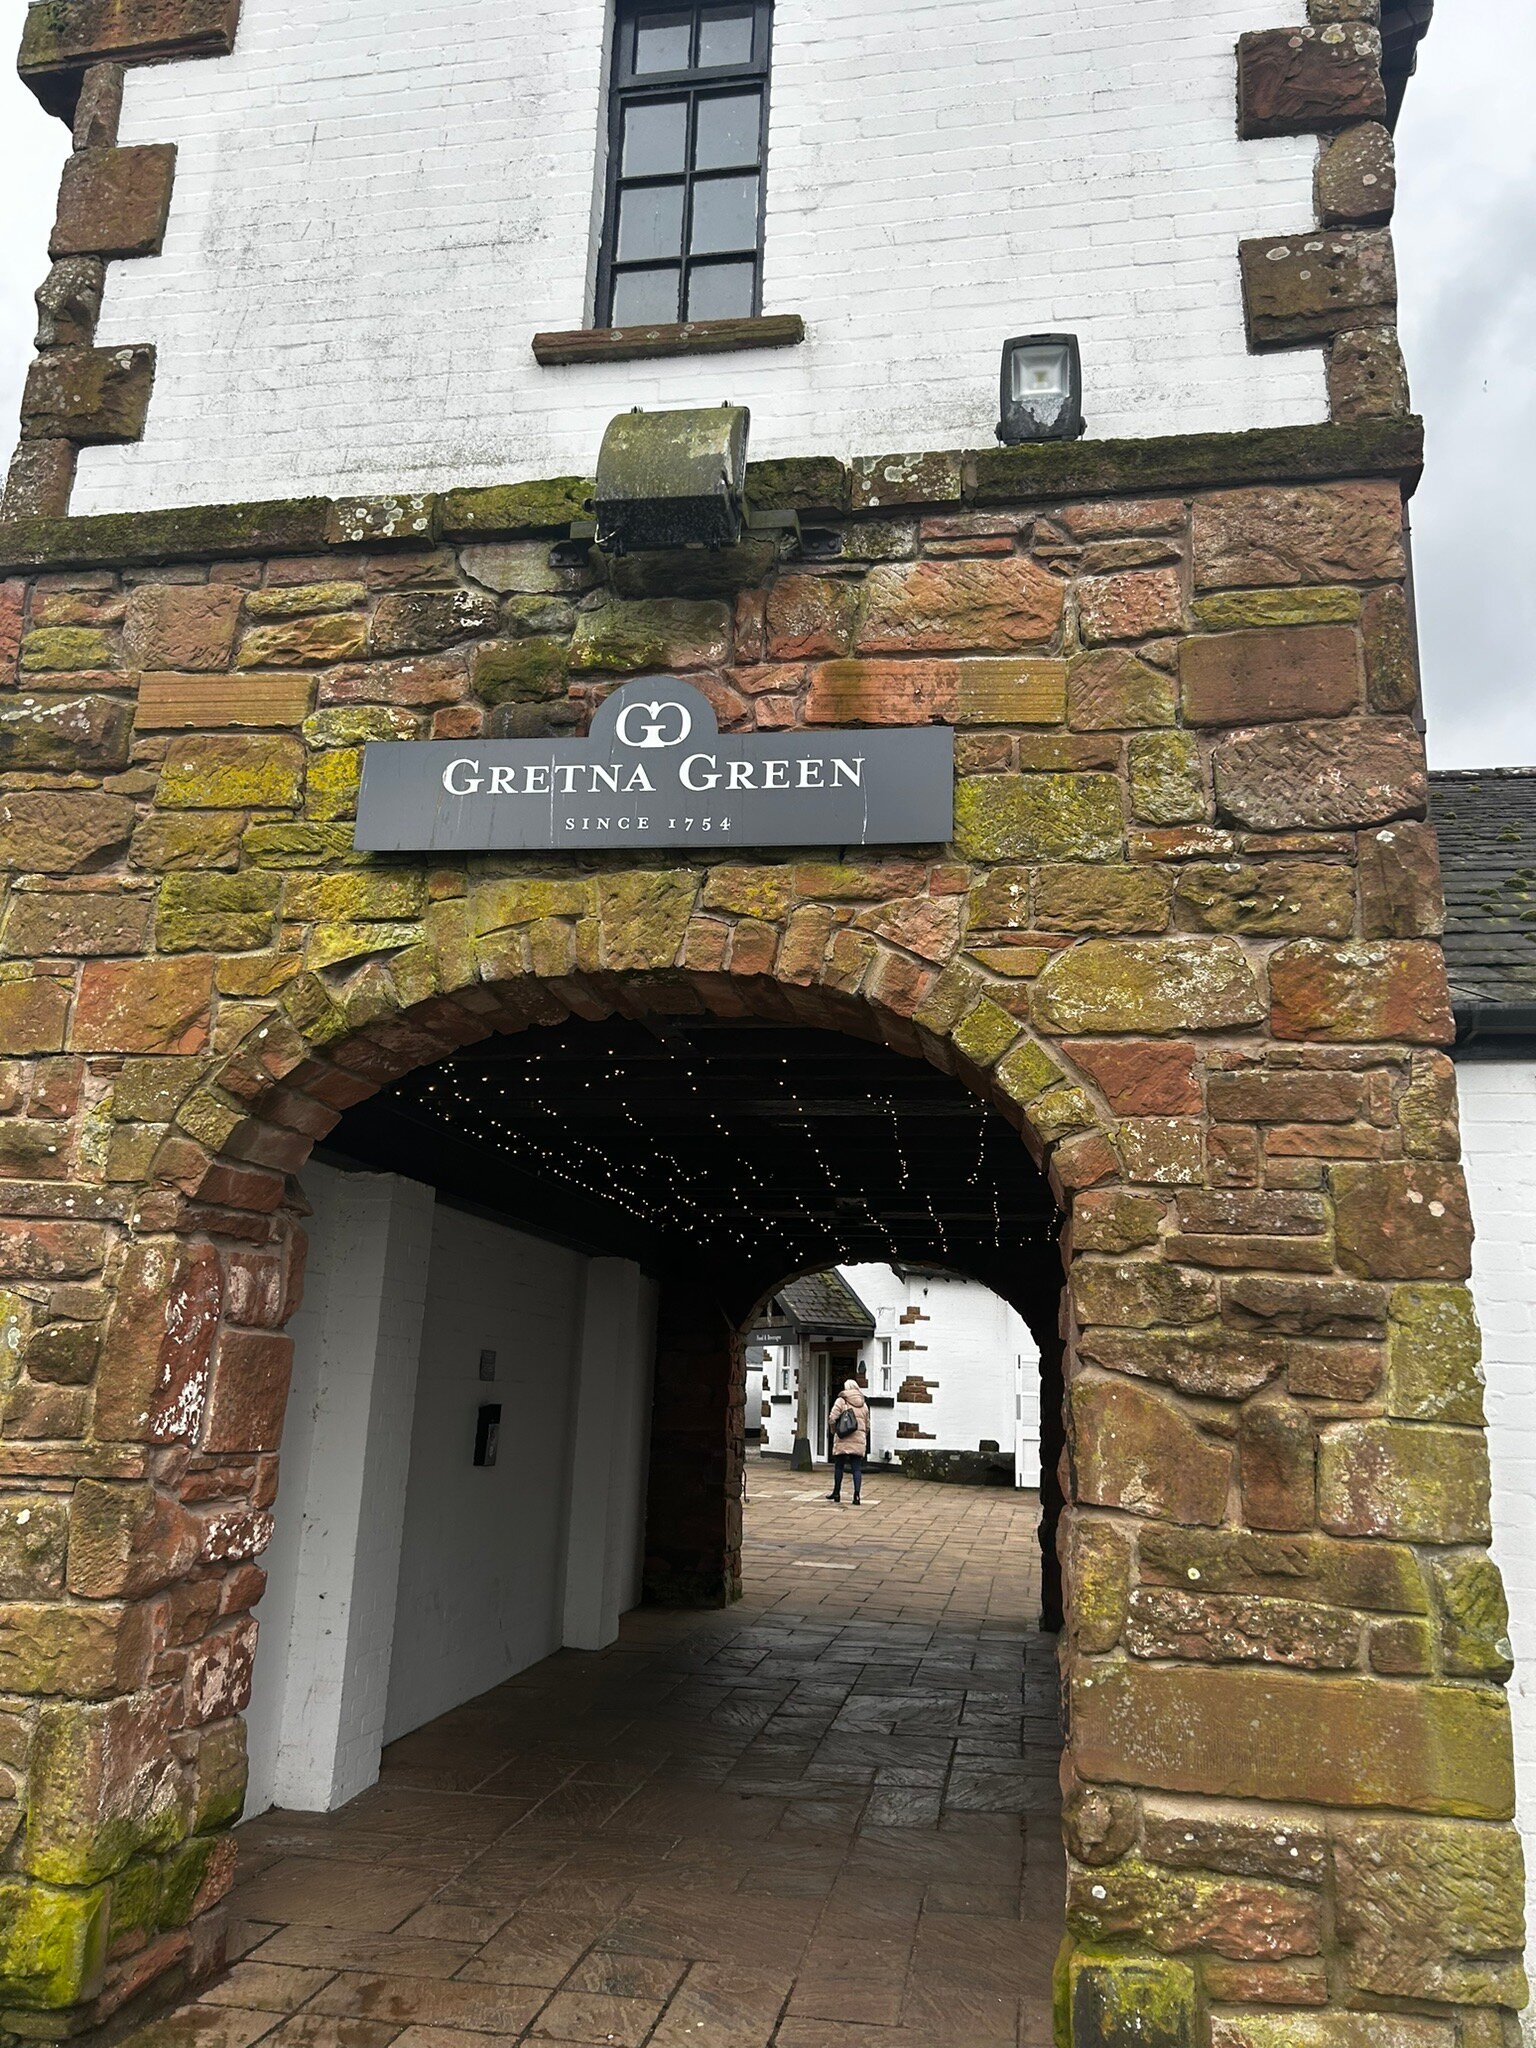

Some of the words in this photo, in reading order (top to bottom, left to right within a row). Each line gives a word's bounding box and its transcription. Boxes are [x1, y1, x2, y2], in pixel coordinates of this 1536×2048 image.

[441, 757, 657, 796] GRETNA
[678, 753, 866, 792] GREEN
[565, 816, 650, 831] SINCE
[668, 816, 732, 832] 1754
